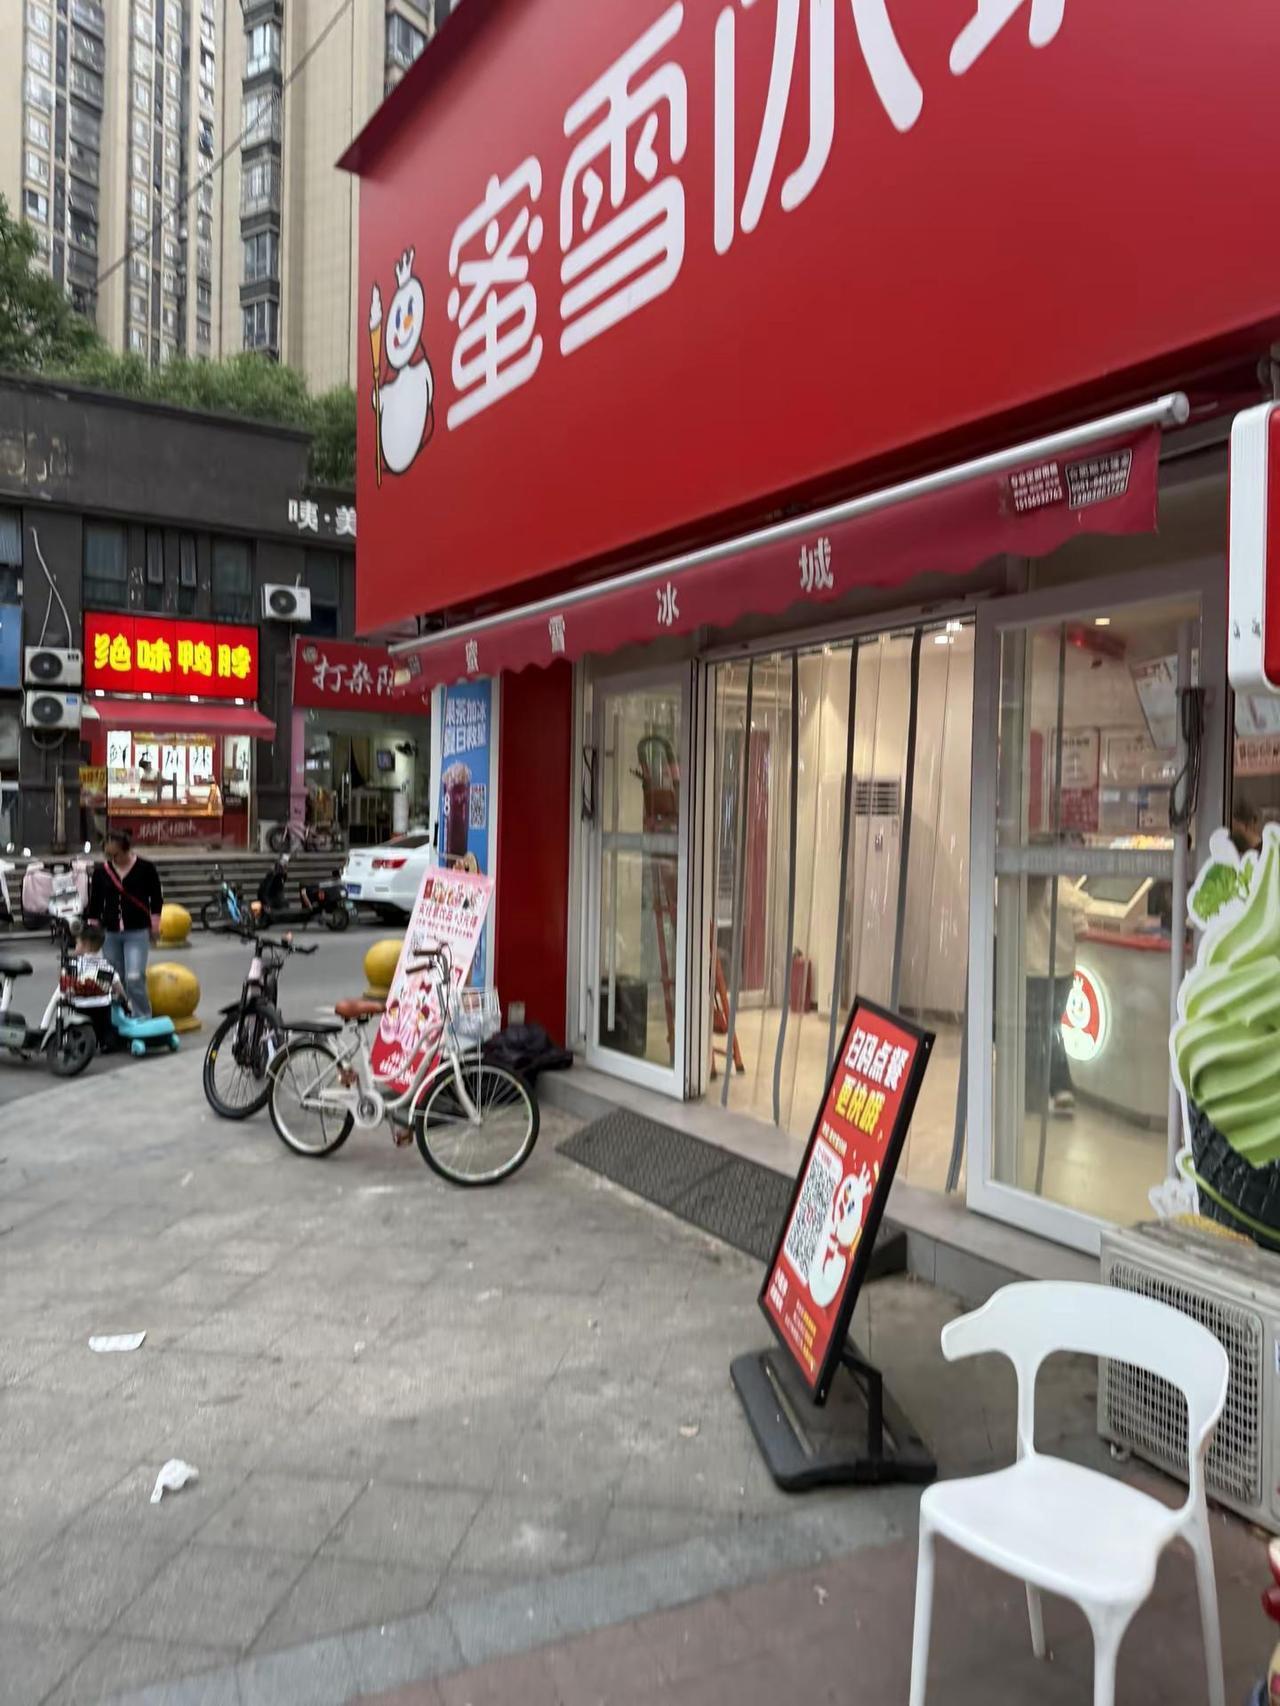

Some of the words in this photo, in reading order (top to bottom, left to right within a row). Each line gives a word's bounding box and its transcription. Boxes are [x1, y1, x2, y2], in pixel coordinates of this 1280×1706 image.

[447, 0, 1066, 431] 蜜雪冰
[94, 633, 251, 679] 绝味鸭脖
[844, 1027, 910, 1092] 扫码点餐
